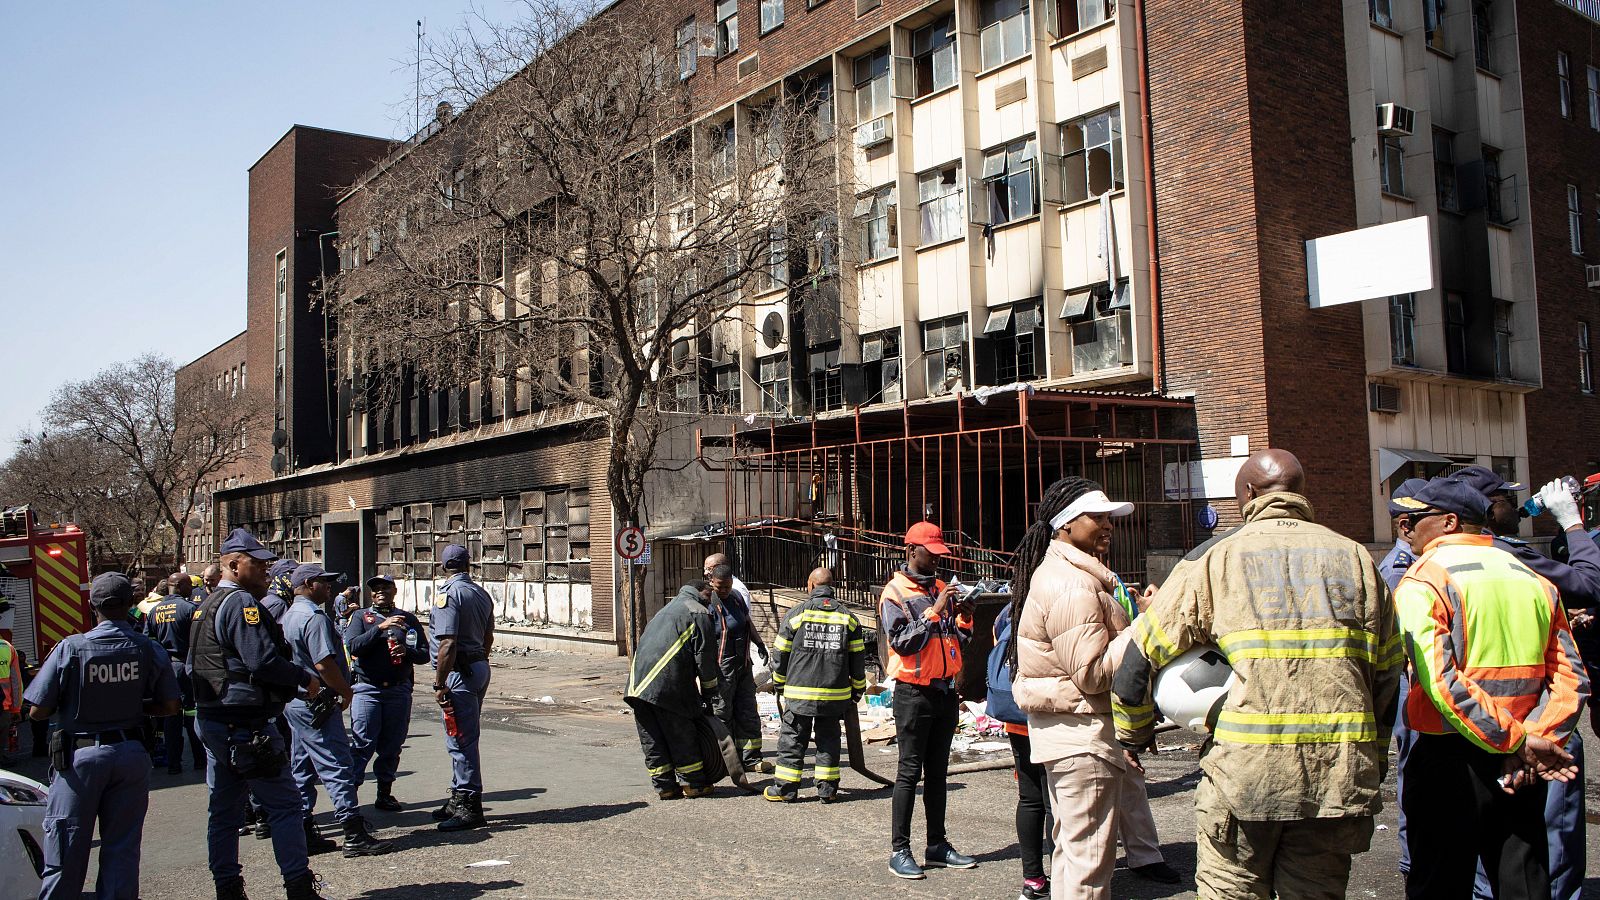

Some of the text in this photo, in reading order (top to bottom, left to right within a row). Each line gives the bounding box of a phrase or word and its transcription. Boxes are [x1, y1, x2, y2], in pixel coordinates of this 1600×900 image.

[1276, 520, 1299, 528] D99
[155, 611, 165, 624] K9
[804, 623, 841, 633] CITY OF
[804, 631, 841, 640] JOHANNESBURG
[803, 640, 841, 649] EMS
[89, 661, 140, 683] POLICE
